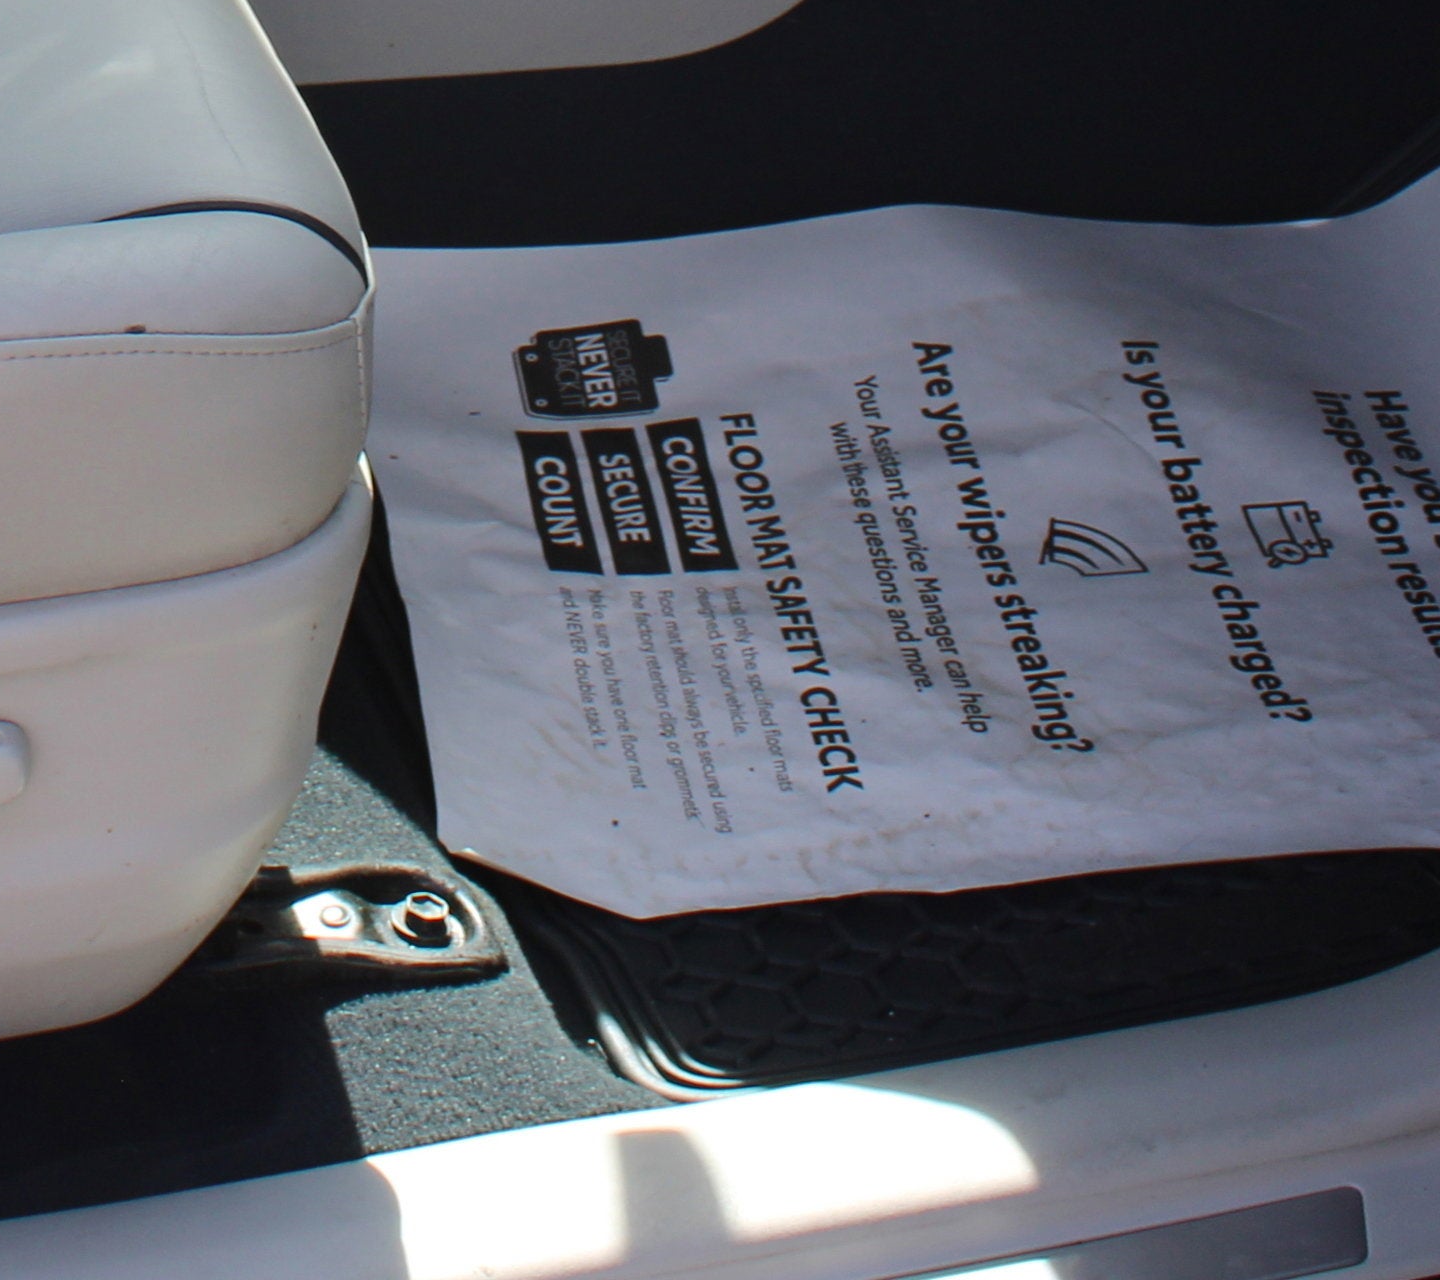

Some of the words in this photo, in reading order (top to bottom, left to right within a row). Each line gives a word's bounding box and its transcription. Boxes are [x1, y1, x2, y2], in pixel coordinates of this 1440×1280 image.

[547, 339, 579, 389] STACK
[573, 333, 617, 408] NEVER
[607, 330, 637, 386] SECURE
[912, 342, 953, 397] Are
[1120, 341, 1157, 365] Is
[853, 375, 882, 419] Your
[1123, 372, 1185, 449] your
[829, 422, 861, 461] with
[921, 403, 980, 469] your
[1364, 390, 1421, 461] Have
[719, 413, 767, 512] FLOOR
[866, 424, 910, 501] Assistant
[1312, 391, 1410, 555] inspection
[533, 456, 582, 547] COUNT
[597, 454, 650, 542] SECURE
[661, 436, 719, 555] CONFIRM
[840, 463, 870, 508] these
[891, 505, 927, 572] Service
[956, 477, 1017, 587] wipers
[1160, 457, 1233, 578] battery
[746, 516, 794, 570] MAT
[855, 512, 908, 603] questions
[628, 590, 648, 609] the
[655, 589, 679, 618] Floor
[913, 577, 959, 655] Manager
[563, 611, 587, 654] NEVER
[593, 623, 611, 648] sure
[635, 611, 660, 653] factory
[663, 621, 683, 645] mat
[763, 575, 829, 676] SAFETY
[887, 608, 917, 642] and
[595, 651, 615, 675] you
[671, 646, 694, 685] should
[709, 643, 728, 660] for
[740, 647, 760, 671] the
[898, 647, 932, 693] more.
[993, 594, 1093, 753] streaking?
[1211, 585, 1311, 723] charged?
[572, 658, 596, 704] double
[605, 678, 627, 706] have
[643, 655, 670, 709] retention
[710, 663, 732, 690] your
[942, 660, 971, 689] can
[582, 706, 604, 737] stack
[612, 709, 630, 733] one
[679, 688, 704, 729] always
[956, 692, 990, 733] help
[619, 734, 642, 763] floor
[667, 741, 683, 755] or
[692, 731, 711, 750] be
[763, 729, 788, 757] floor
[798, 685, 862, 794] CHECK
[625, 765, 646, 789] mat
[697, 750, 725, 798] secured
[772, 760, 793, 792] mats
[710, 801, 733, 834] using
